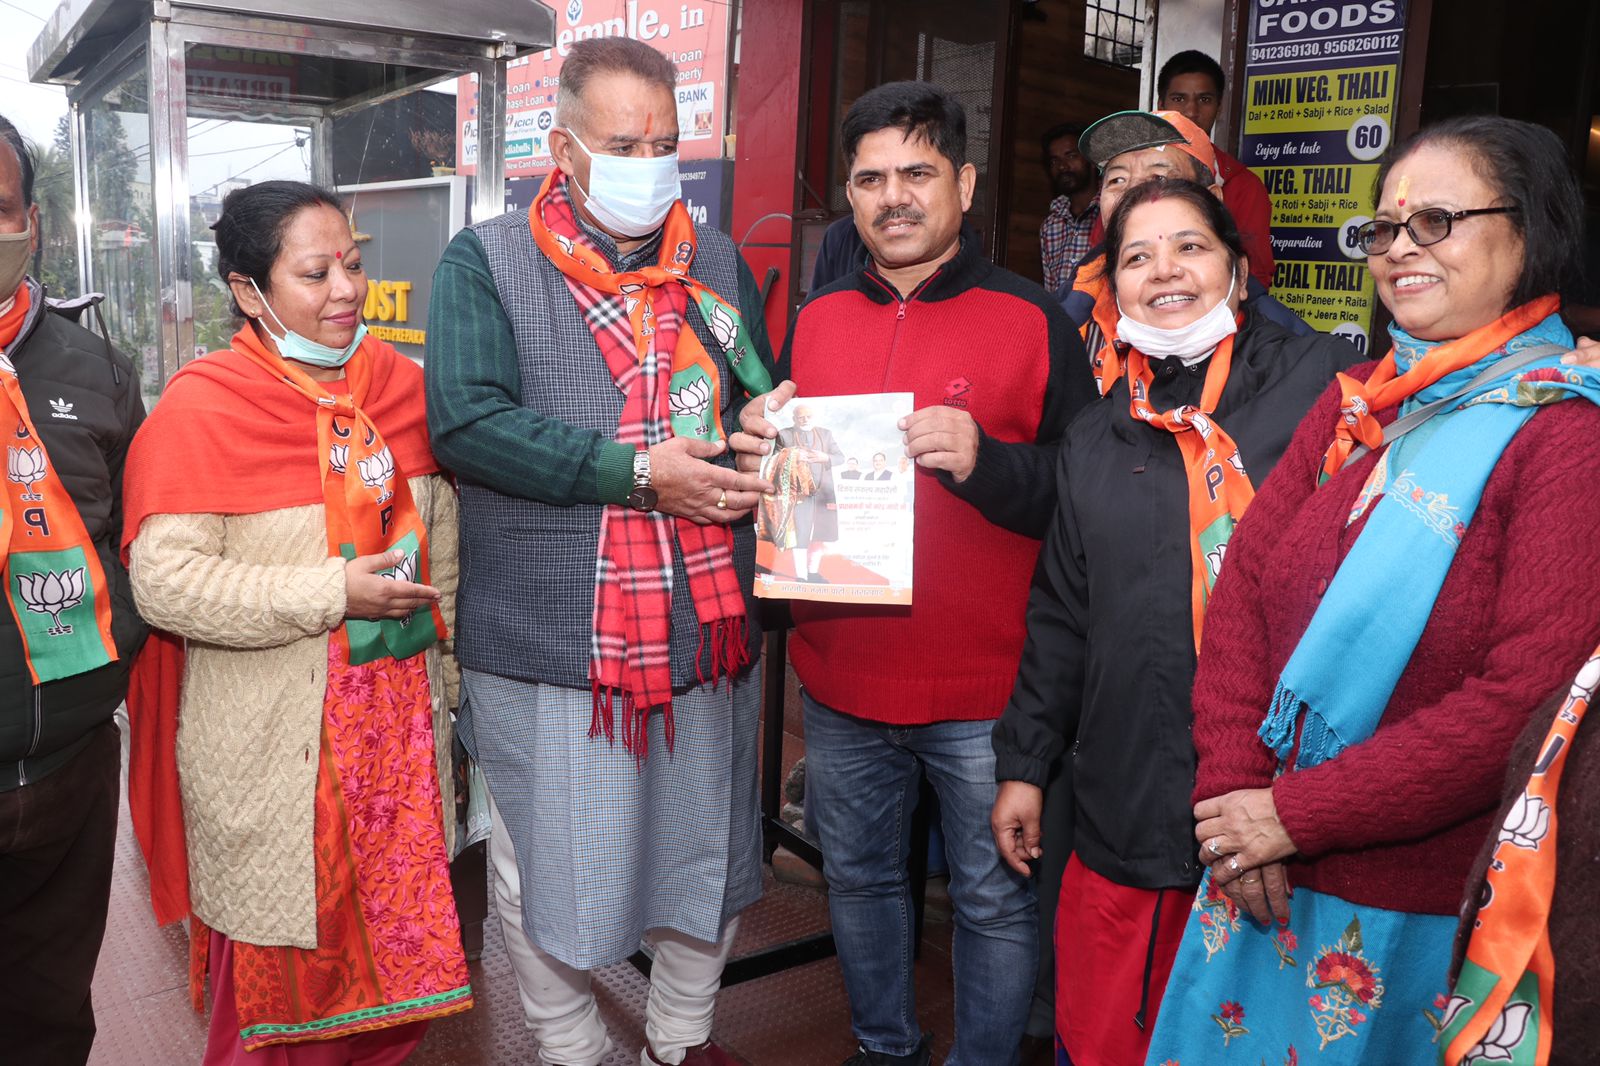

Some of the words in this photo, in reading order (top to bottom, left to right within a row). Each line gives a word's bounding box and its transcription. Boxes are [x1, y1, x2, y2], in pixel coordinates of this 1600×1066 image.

[680, 5, 704, 30] in
[1259, 0, 1396, 37] FOODS
[1252, 43, 1322, 61] 9412369130,
[1324, 35, 1400, 54] 9568260112
[673, 49, 702, 64] Loan
[506, 83, 530, 95] Loan
[679, 88, 708, 104] BANK
[1253, 78, 1293, 107] MINI
[1296, 75, 1332, 104] VEG.
[1337, 71, 1389, 101] THALI
[526, 96, 545, 107] Loan
[1249, 111, 1262, 121] Dal
[1270, 111, 1275, 120] 2
[1277, 109, 1294, 119] Roti
[1303, 108, 1325, 120] Sabji
[1334, 106, 1353, 117] Rice
[1363, 104, 1389, 115] Salad
[1355, 125, 1383, 149] 60
[1256, 143, 1280, 160] Enjoy
[1283, 142, 1297, 155] the
[1300, 141, 1321, 154] taste
[1264, 169, 1298, 195] VEG.
[1303, 168, 1352, 195] THALI
[1275, 201, 1280, 210] 4
[1282, 200, 1299, 210] Roti
[1308, 200, 1329, 211] Sabji
[1339, 199, 1358, 210] Rice
[1312, 213, 1333, 223] Raita
[1346, 225, 1358, 248] 8
[1271, 262, 1311, 289] CIAL
[1315, 264, 1364, 291] THALI
[1286, 293, 1304, 304] Sahi
[1306, 294, 1336, 305] Paneer
[1345, 296, 1368, 308] Raita
[1314, 309, 1338, 320] Jeera
[1340, 311, 1359, 322] Rice
[944, 398, 967, 407] lotto
[51, 412, 78, 420] adidas
